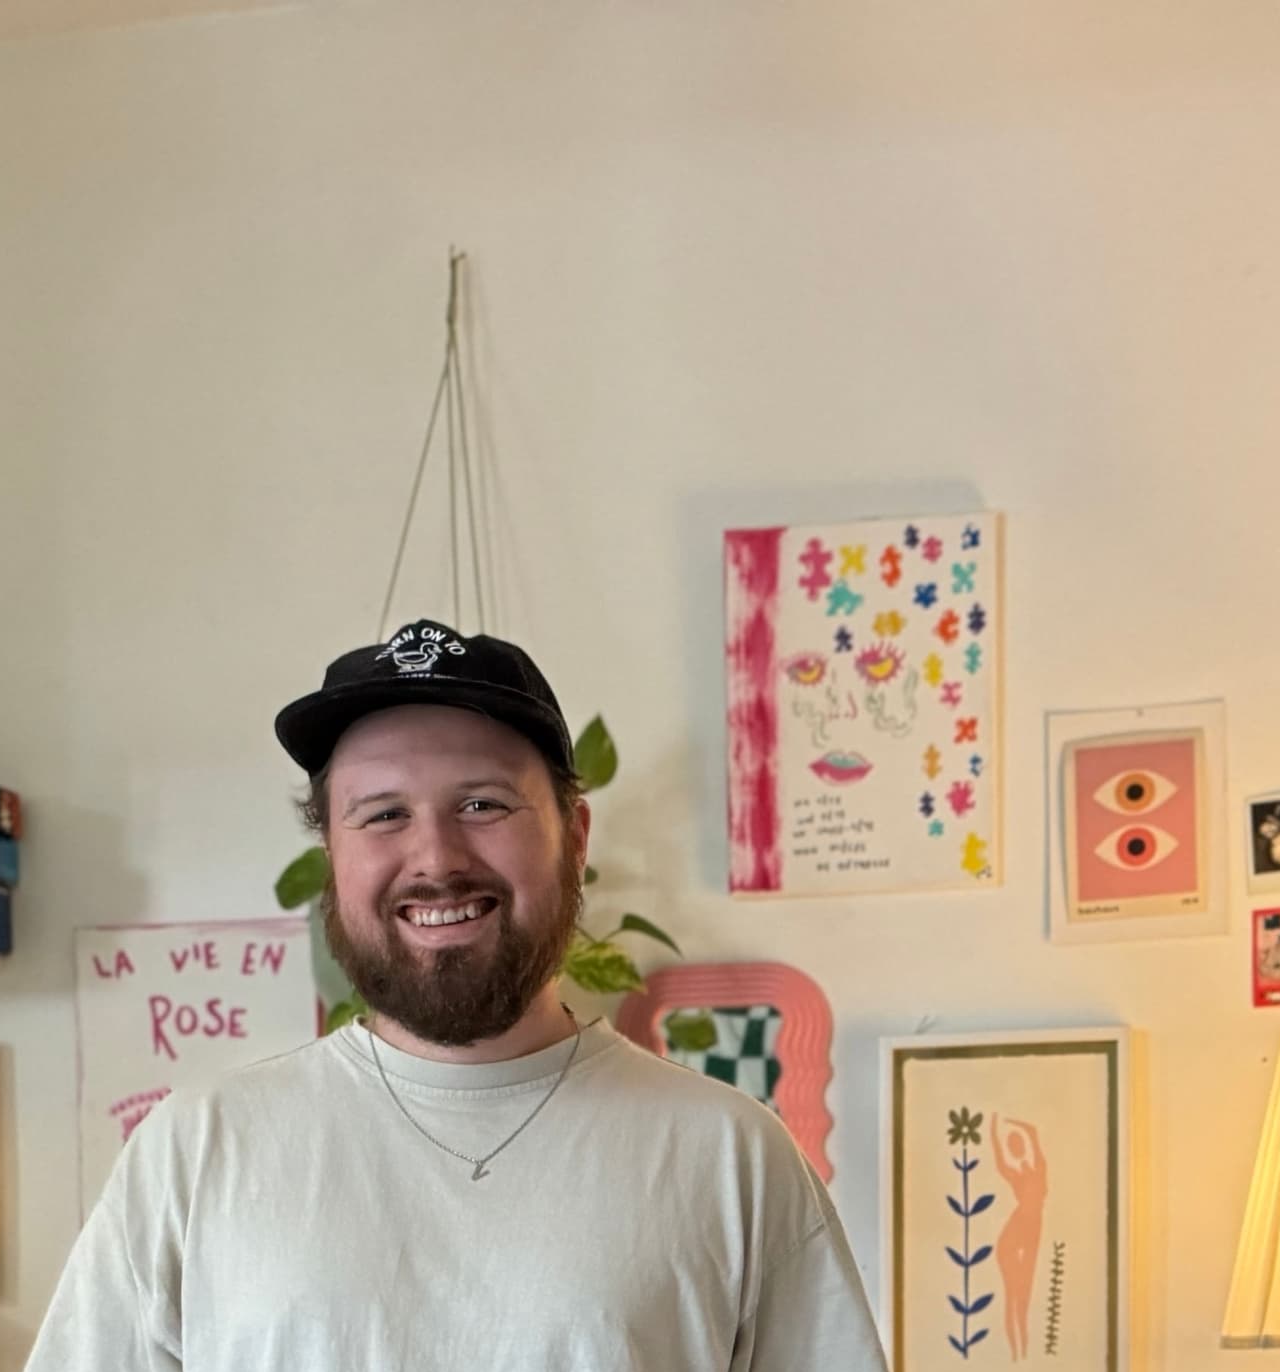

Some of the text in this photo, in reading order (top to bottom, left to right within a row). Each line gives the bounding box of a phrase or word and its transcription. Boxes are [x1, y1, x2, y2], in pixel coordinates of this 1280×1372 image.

[420, 627, 447, 643] ON
[443, 640, 466, 655] TO
[93, 941, 286, 980] LA VIE EN
[148, 995, 248, 1061] ROSE
